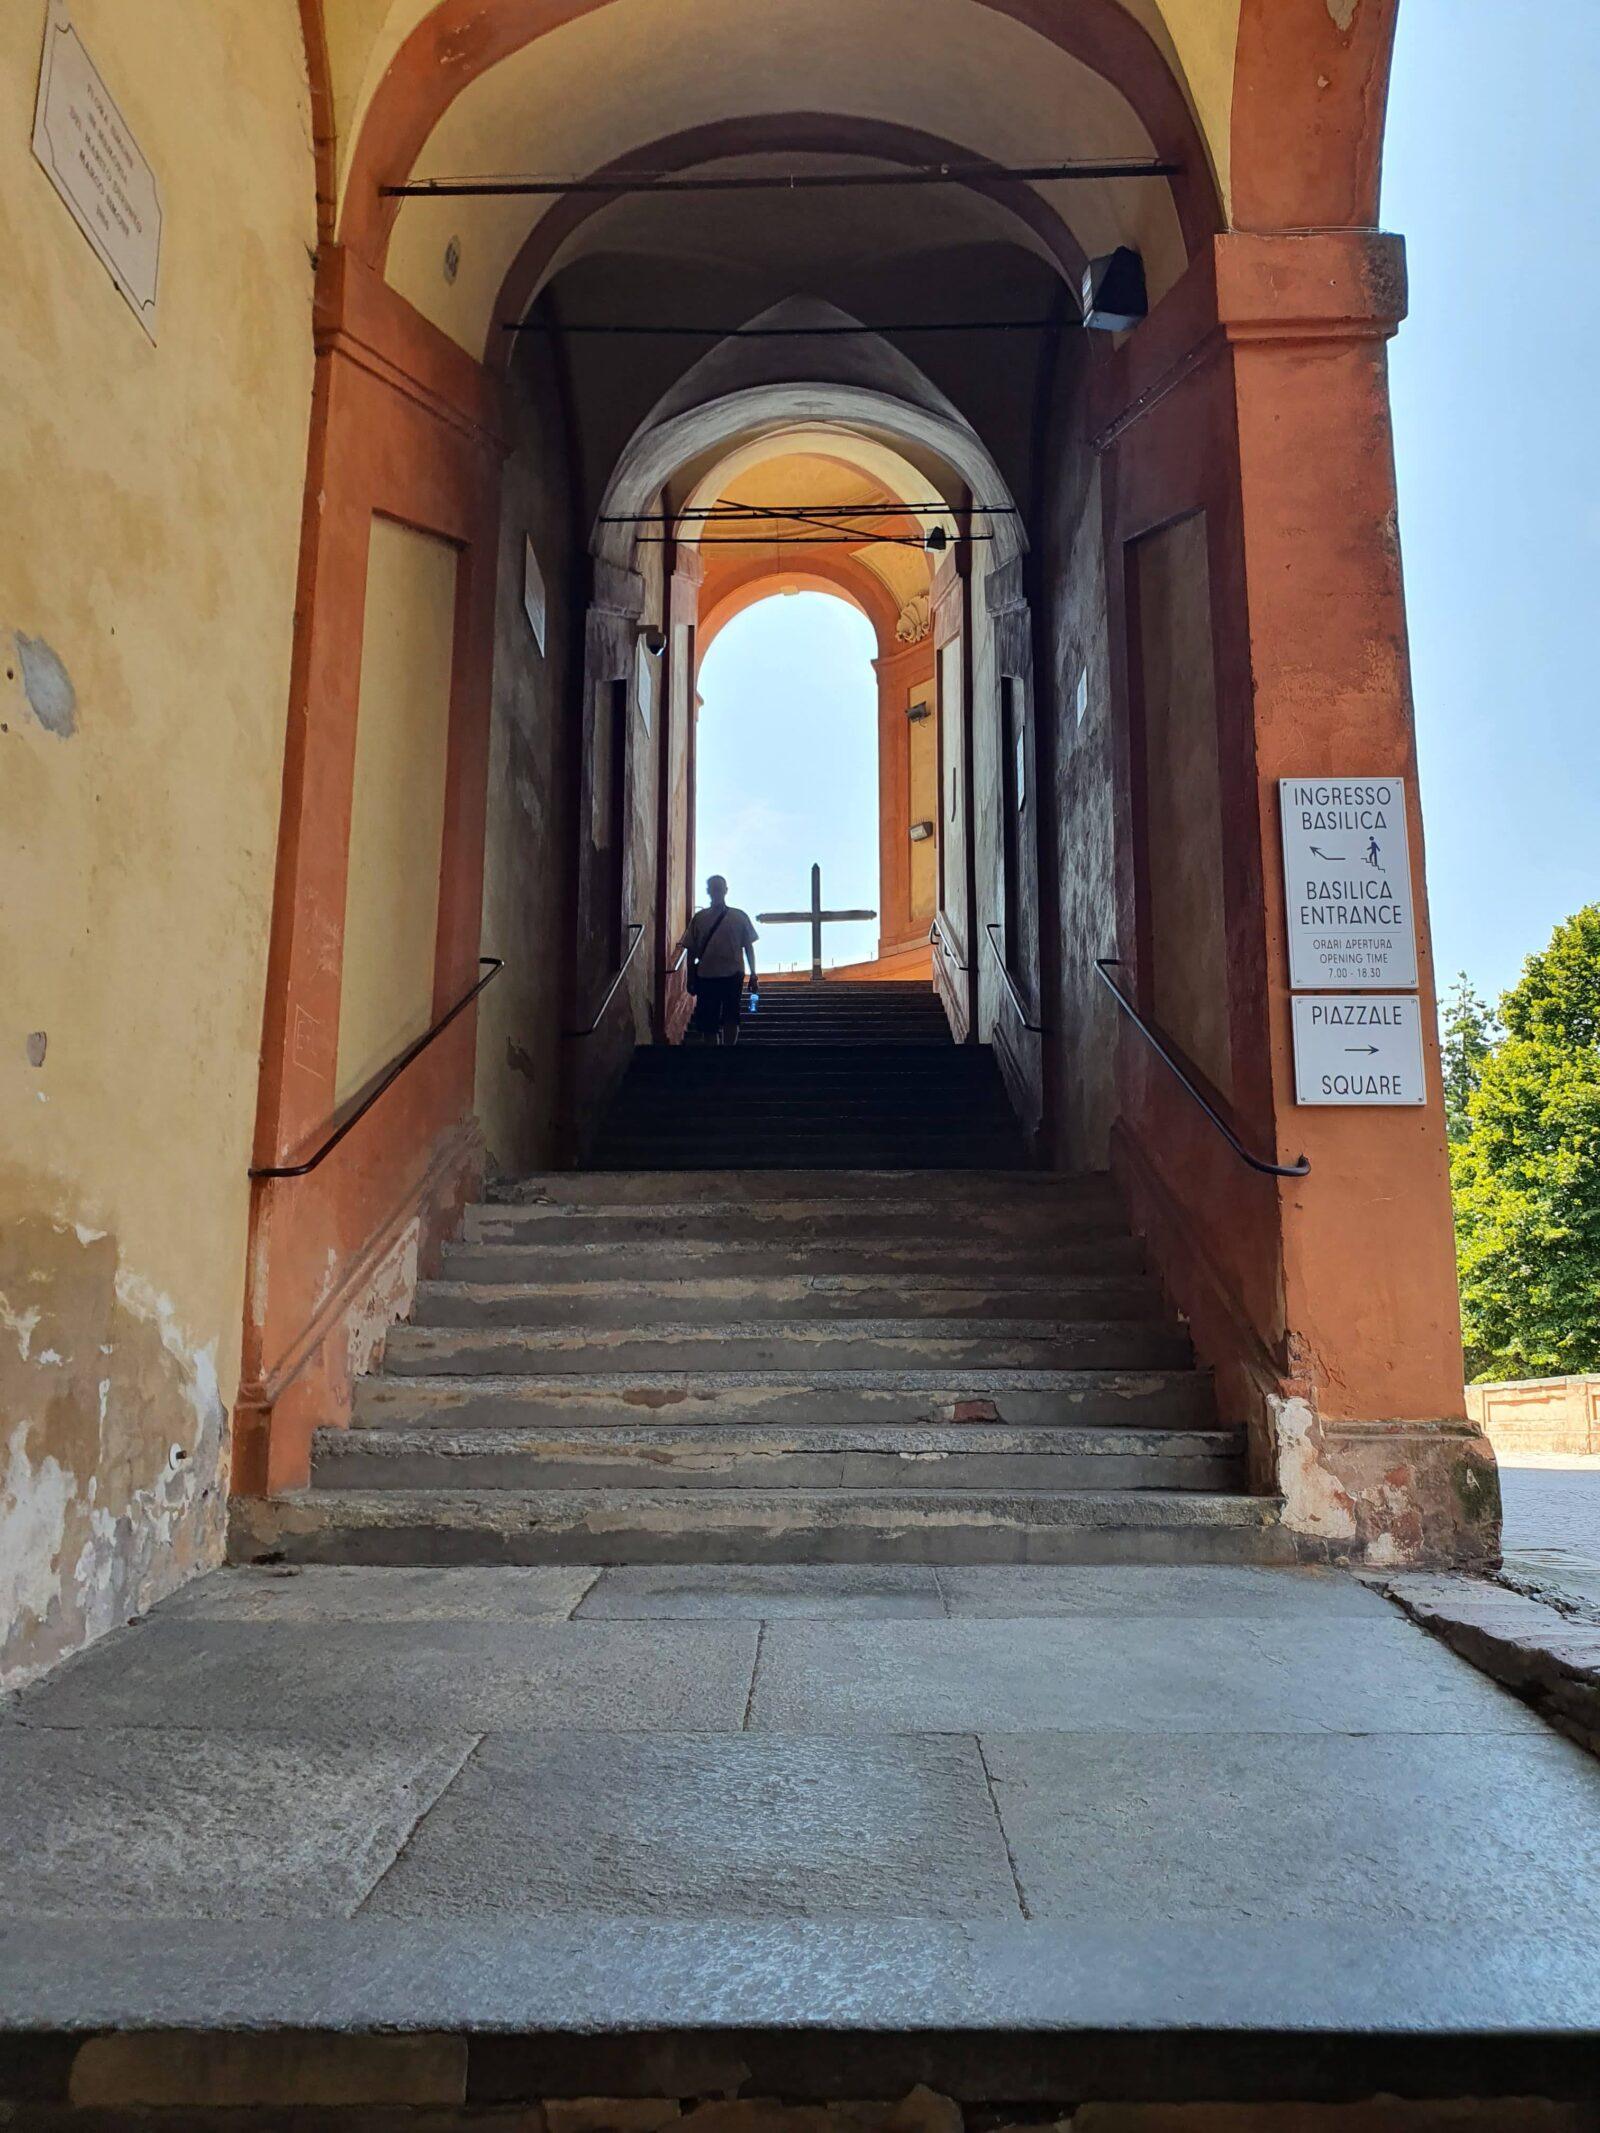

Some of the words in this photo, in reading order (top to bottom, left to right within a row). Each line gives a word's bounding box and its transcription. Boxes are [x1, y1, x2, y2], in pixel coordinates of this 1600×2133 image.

[1294, 786, 1391, 806] INGRESSO
[1302, 811, 1387, 830] BASILICA
[1306, 880, 1392, 900] BASILICA
[1301, 905, 1402, 925] ENTRANCE
[1313, 939, 1341, 949] ORARI
[1345, 938, 1393, 949] APERTURA
[1320, 953, 1363, 964] OPENING
[1366, 953, 1388, 963] TIME
[1328, 967, 1348, 978] 7.00
[1357, 967, 1381, 978] 18.30
[1312, 1005, 1402, 1025] PIAZZALE
[1322, 1075, 1402, 1095] SQUARE
